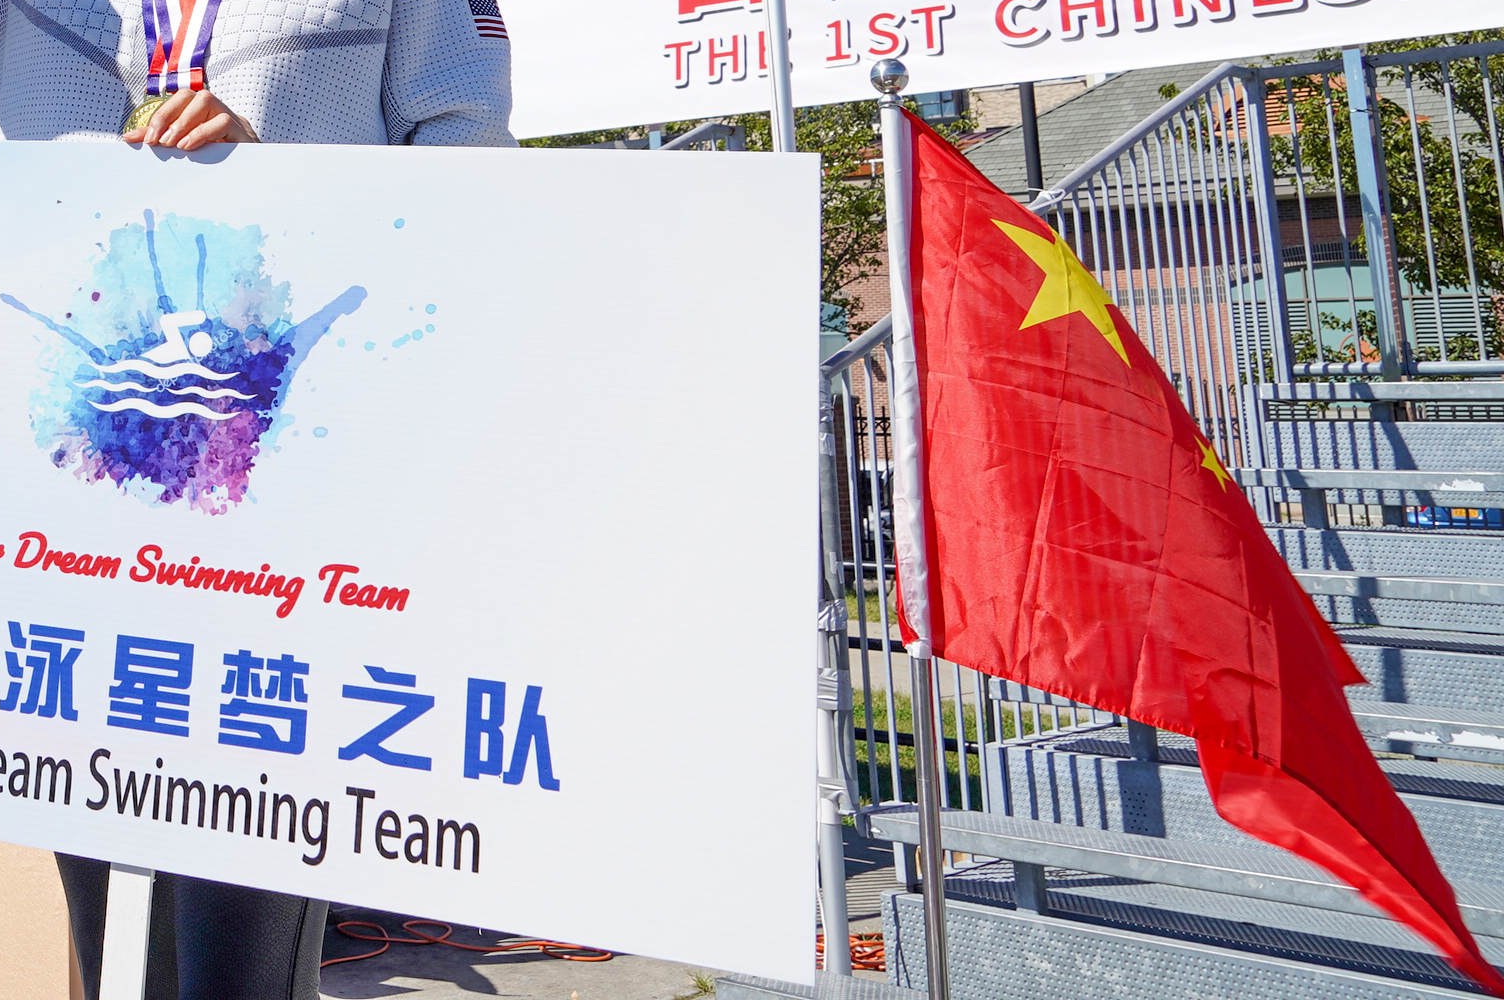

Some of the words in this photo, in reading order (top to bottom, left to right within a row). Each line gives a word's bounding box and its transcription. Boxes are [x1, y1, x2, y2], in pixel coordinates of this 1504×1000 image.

[825, 4, 951, 63] 1ST
[13, 531, 122, 579] Dream
[129, 544, 305, 619] Swimming
[318, 563, 410, 612] Team
[85, 748, 331, 866] Swimming
[346, 786, 481, 873] Team
